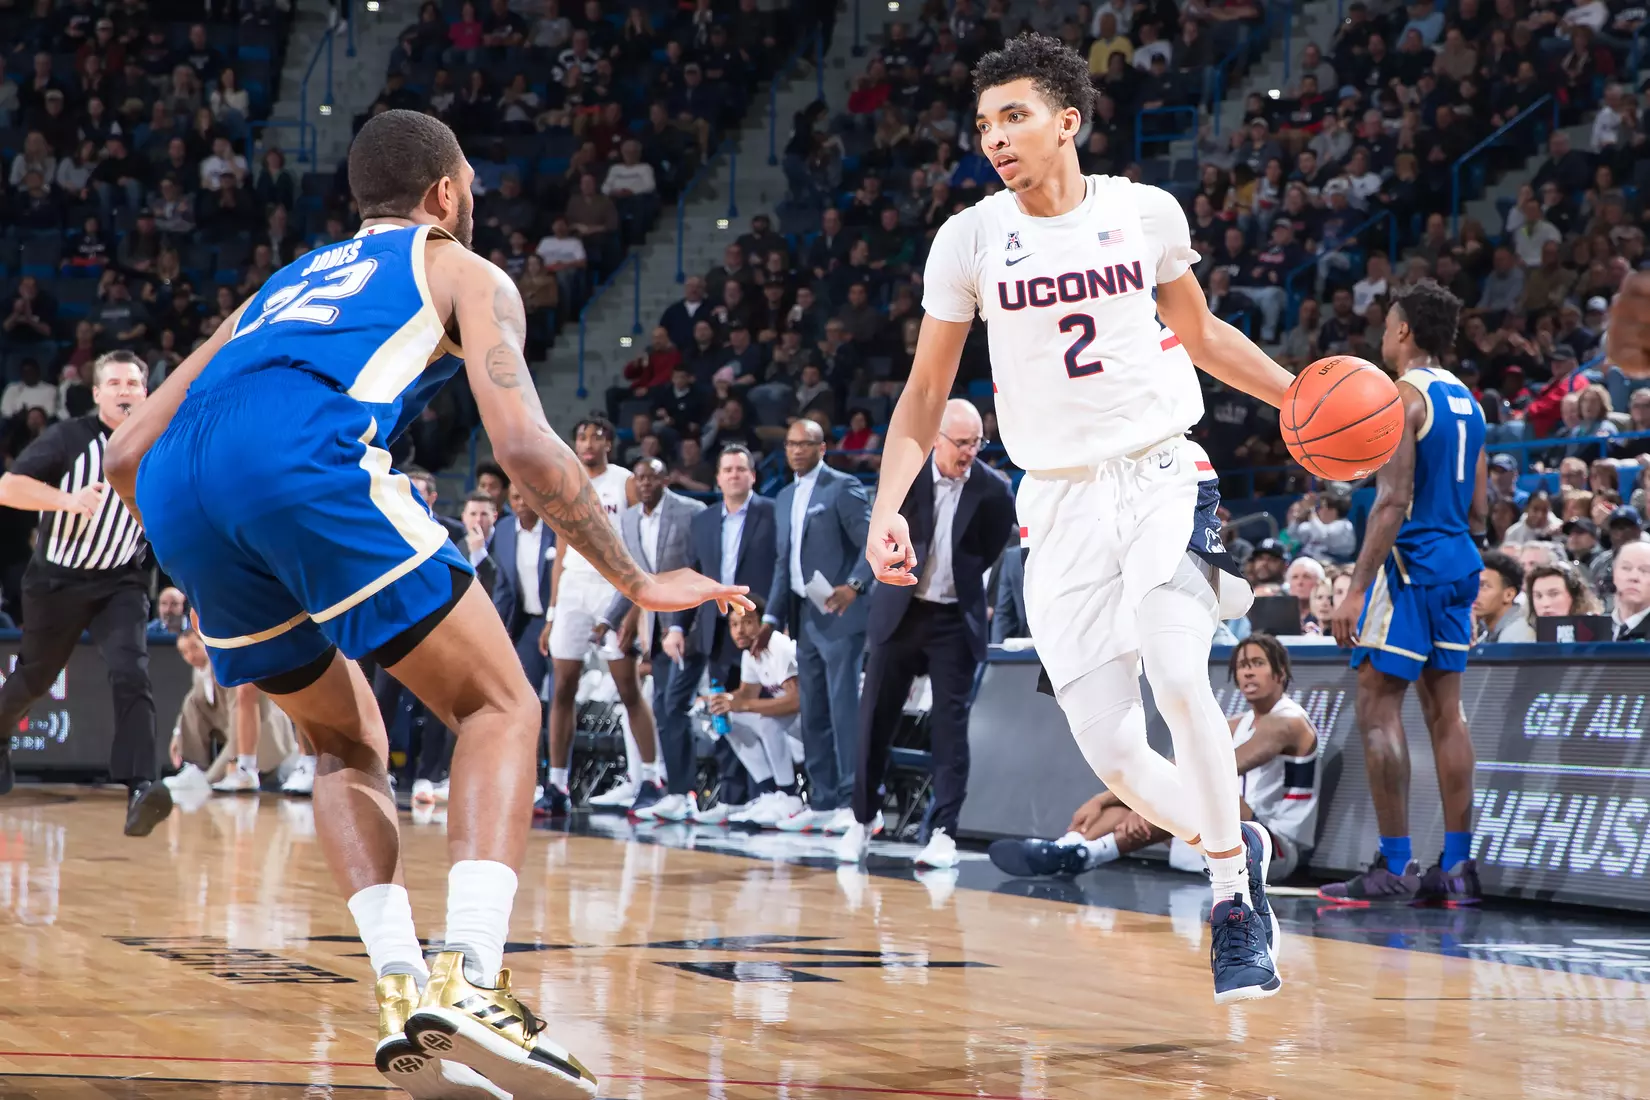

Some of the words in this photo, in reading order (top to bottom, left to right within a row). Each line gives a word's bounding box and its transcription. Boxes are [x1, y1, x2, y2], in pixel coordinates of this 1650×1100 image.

[301, 240, 363, 277] JONES
[998, 260, 1144, 311] UCONN
[1058, 313, 1104, 379] 2
[1456, 419, 1467, 483] 1
[1523, 693, 1589, 738] GET
[1583, 694, 1645, 739] ALL
[1470, 788, 1650, 878] HEHUS
